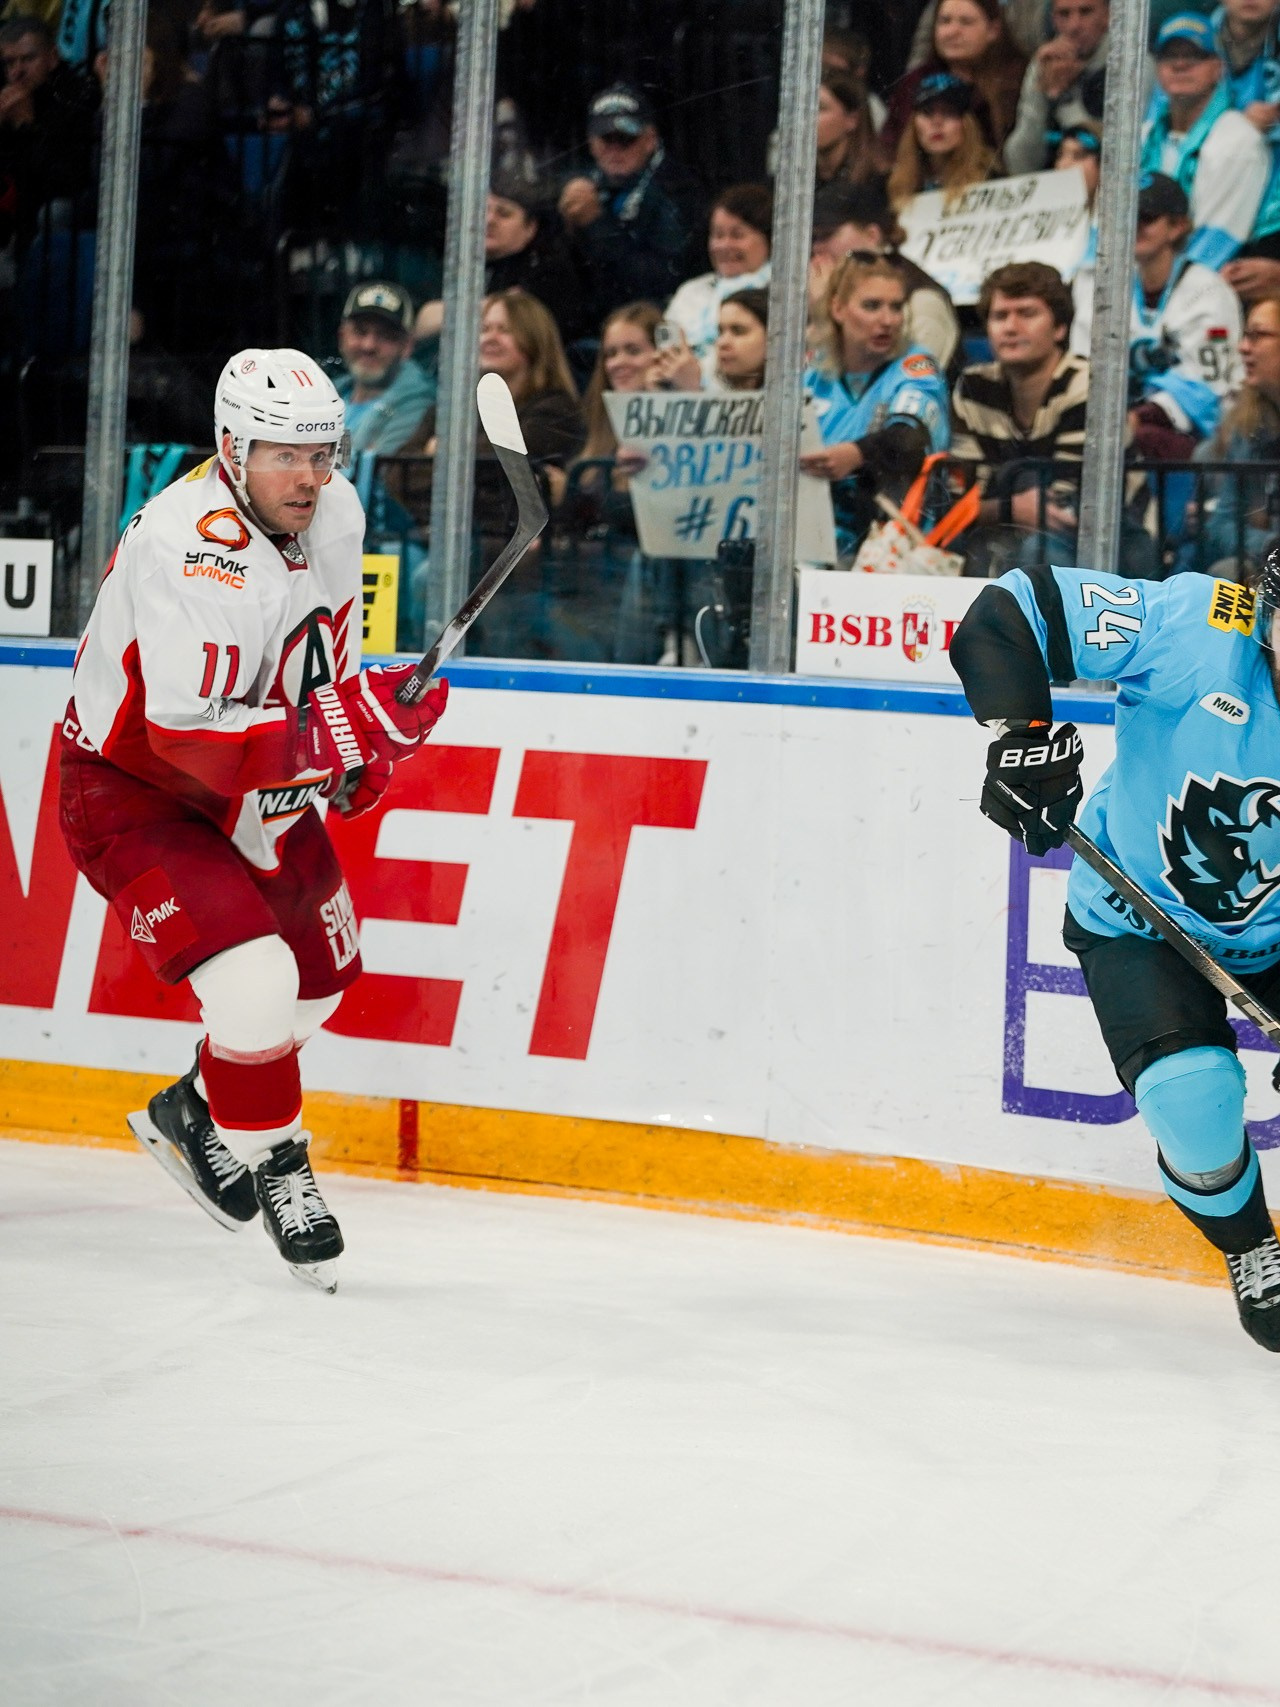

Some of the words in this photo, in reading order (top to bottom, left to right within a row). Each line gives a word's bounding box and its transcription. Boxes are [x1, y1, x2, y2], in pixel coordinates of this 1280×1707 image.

[291, 370, 313, 387] 11
[296, 421, 336, 432] согаз
[183, 564, 245, 589] UMMC
[184, 551, 249, 577] УГМК
[1080, 582, 1143, 651] 24
[1213, 583, 1236, 625] LINE
[808, 612, 893, 647] BSB
[198, 641, 240, 698] 11
[999, 731, 1083, 768] BAUE
[259, 785, 322, 816] NLIN
[1102, 889, 1163, 939] BS
